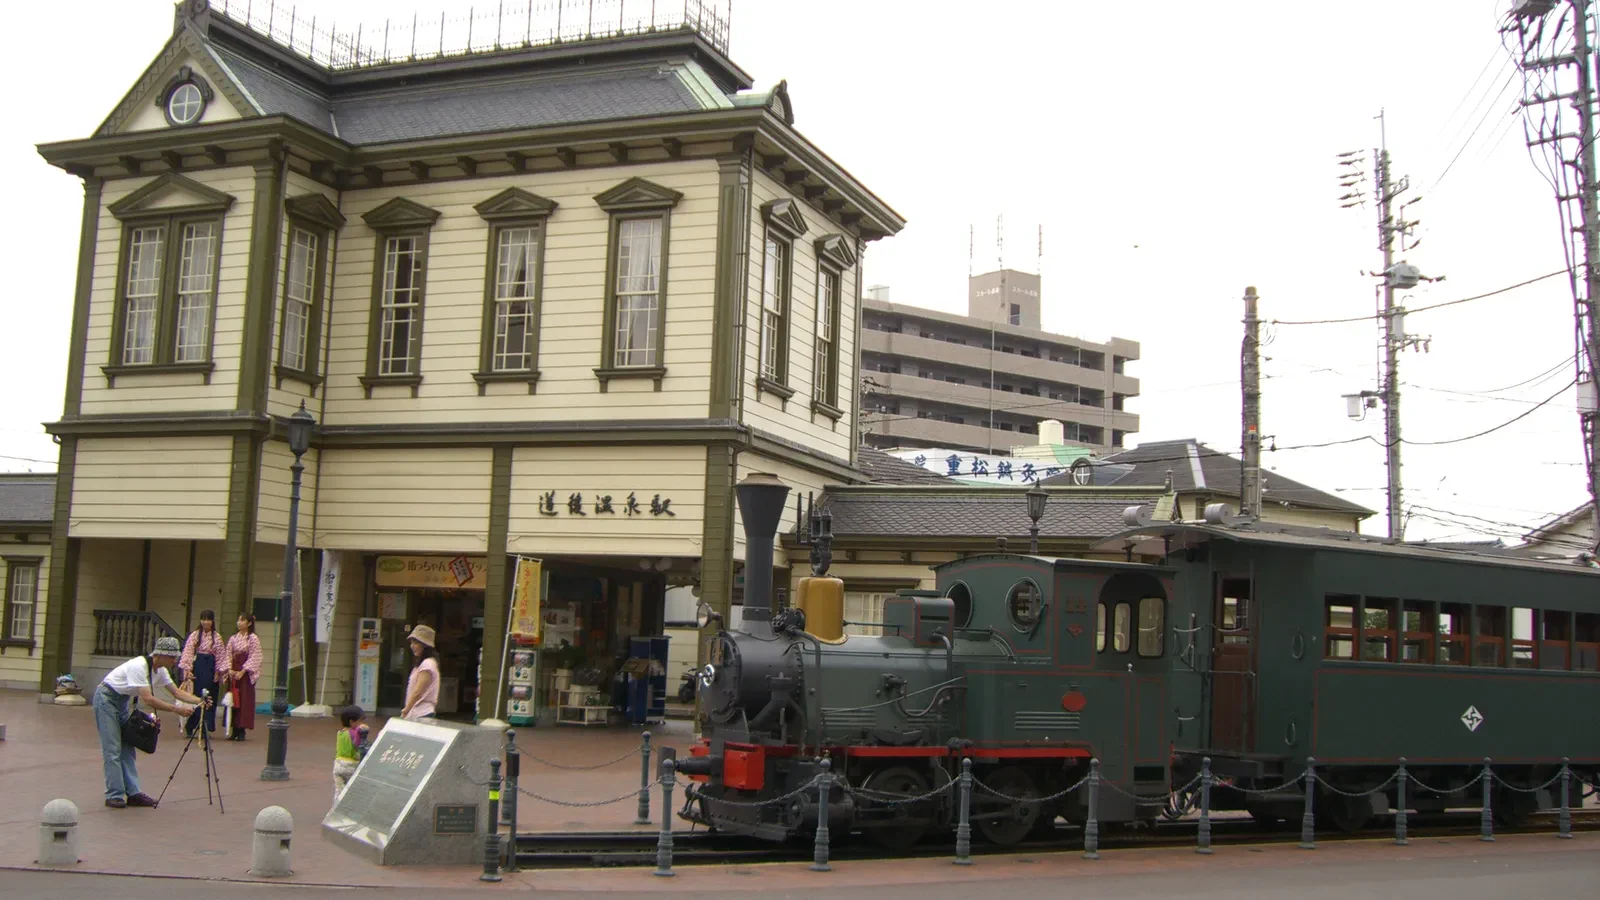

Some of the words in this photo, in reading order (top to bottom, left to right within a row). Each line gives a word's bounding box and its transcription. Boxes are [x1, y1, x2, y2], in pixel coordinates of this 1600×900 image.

[538, 489, 677, 518] 道後温泉駅
